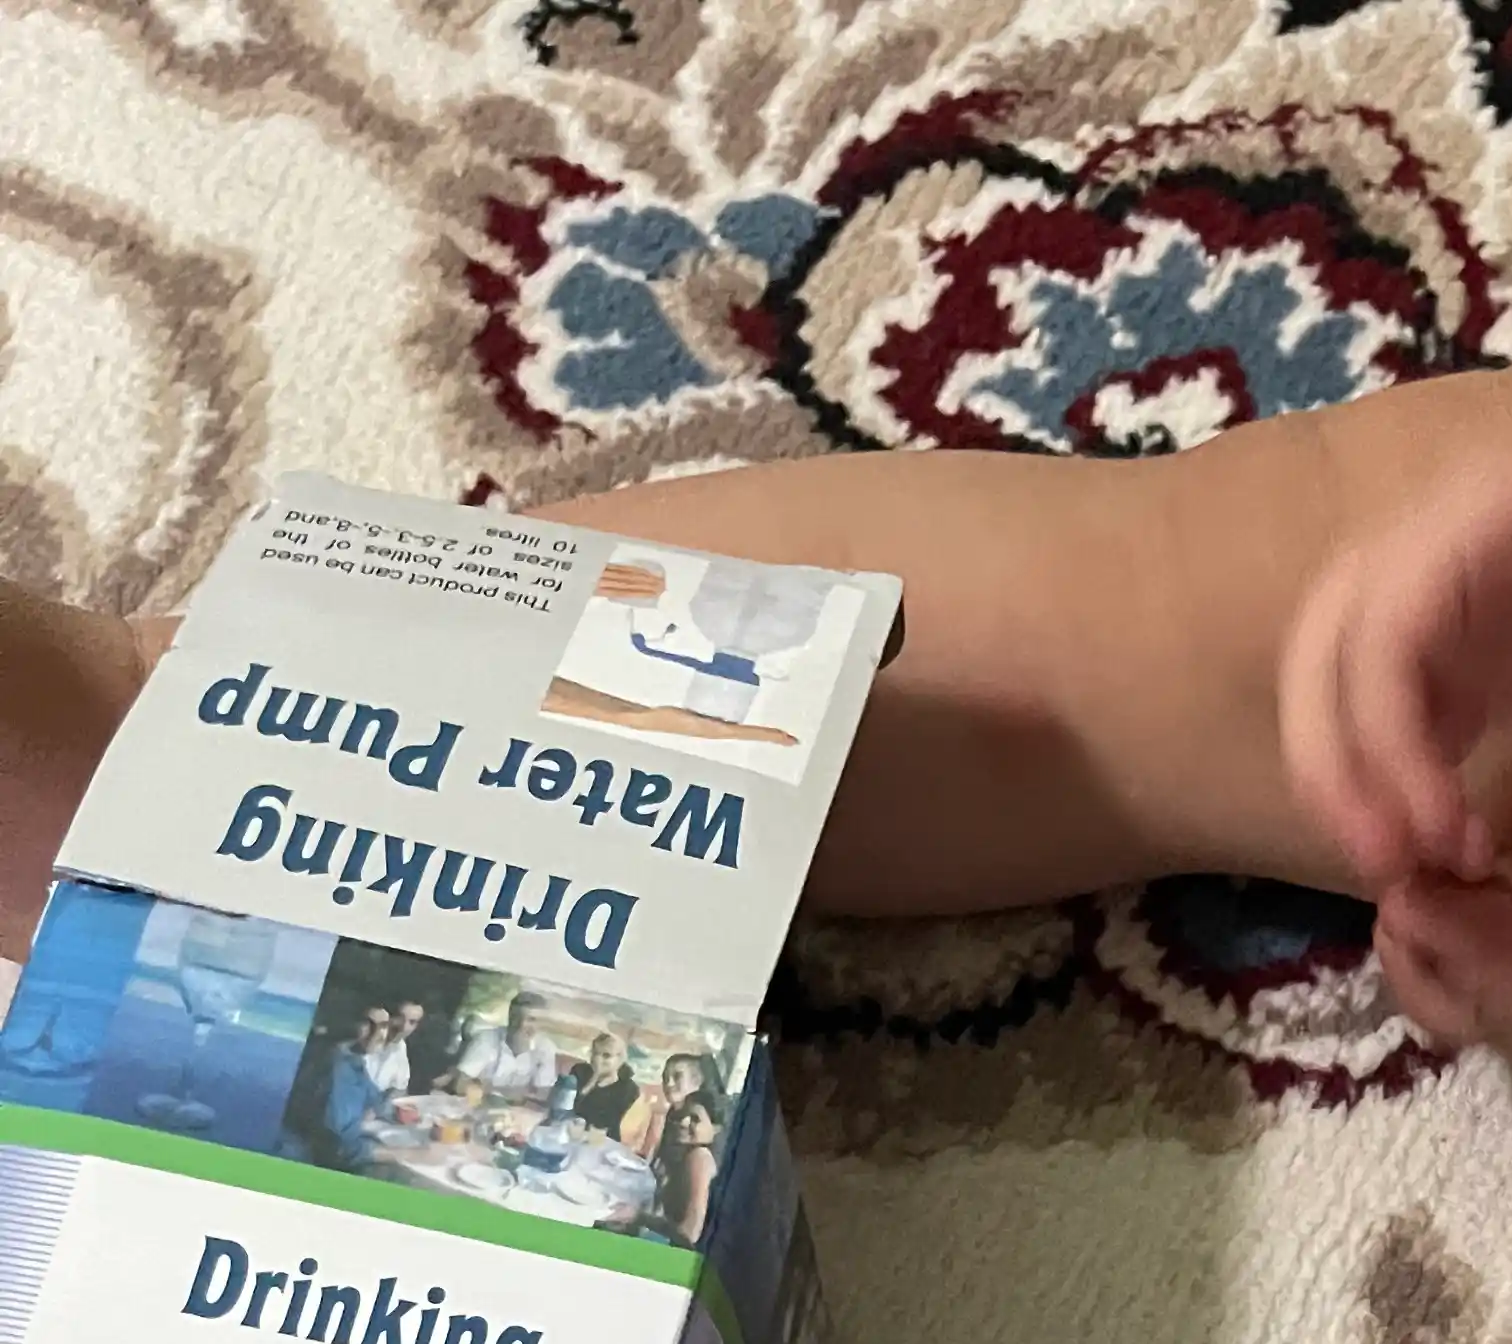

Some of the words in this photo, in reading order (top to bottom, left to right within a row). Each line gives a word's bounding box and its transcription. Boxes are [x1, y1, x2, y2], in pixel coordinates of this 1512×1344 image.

[272, 529, 310, 547] the
[324, 538, 353, 552] of
[552, 540, 579, 556] 10
[260, 548, 320, 567] used
[364, 544, 444, 571] bottles
[466, 544, 494, 557] of
[325, 558, 356, 576] be
[360, 564, 405, 580] can
[452, 561, 520, 583] water
[513, 552, 574, 573] sizes
[407, 572, 501, 598] product
[530, 576, 564, 594] for
[504, 591, 551, 614] This
[198, 663, 466, 792] Pump
[479, 737, 746, 870] Water
[216, 785, 641, 970] Drinking
